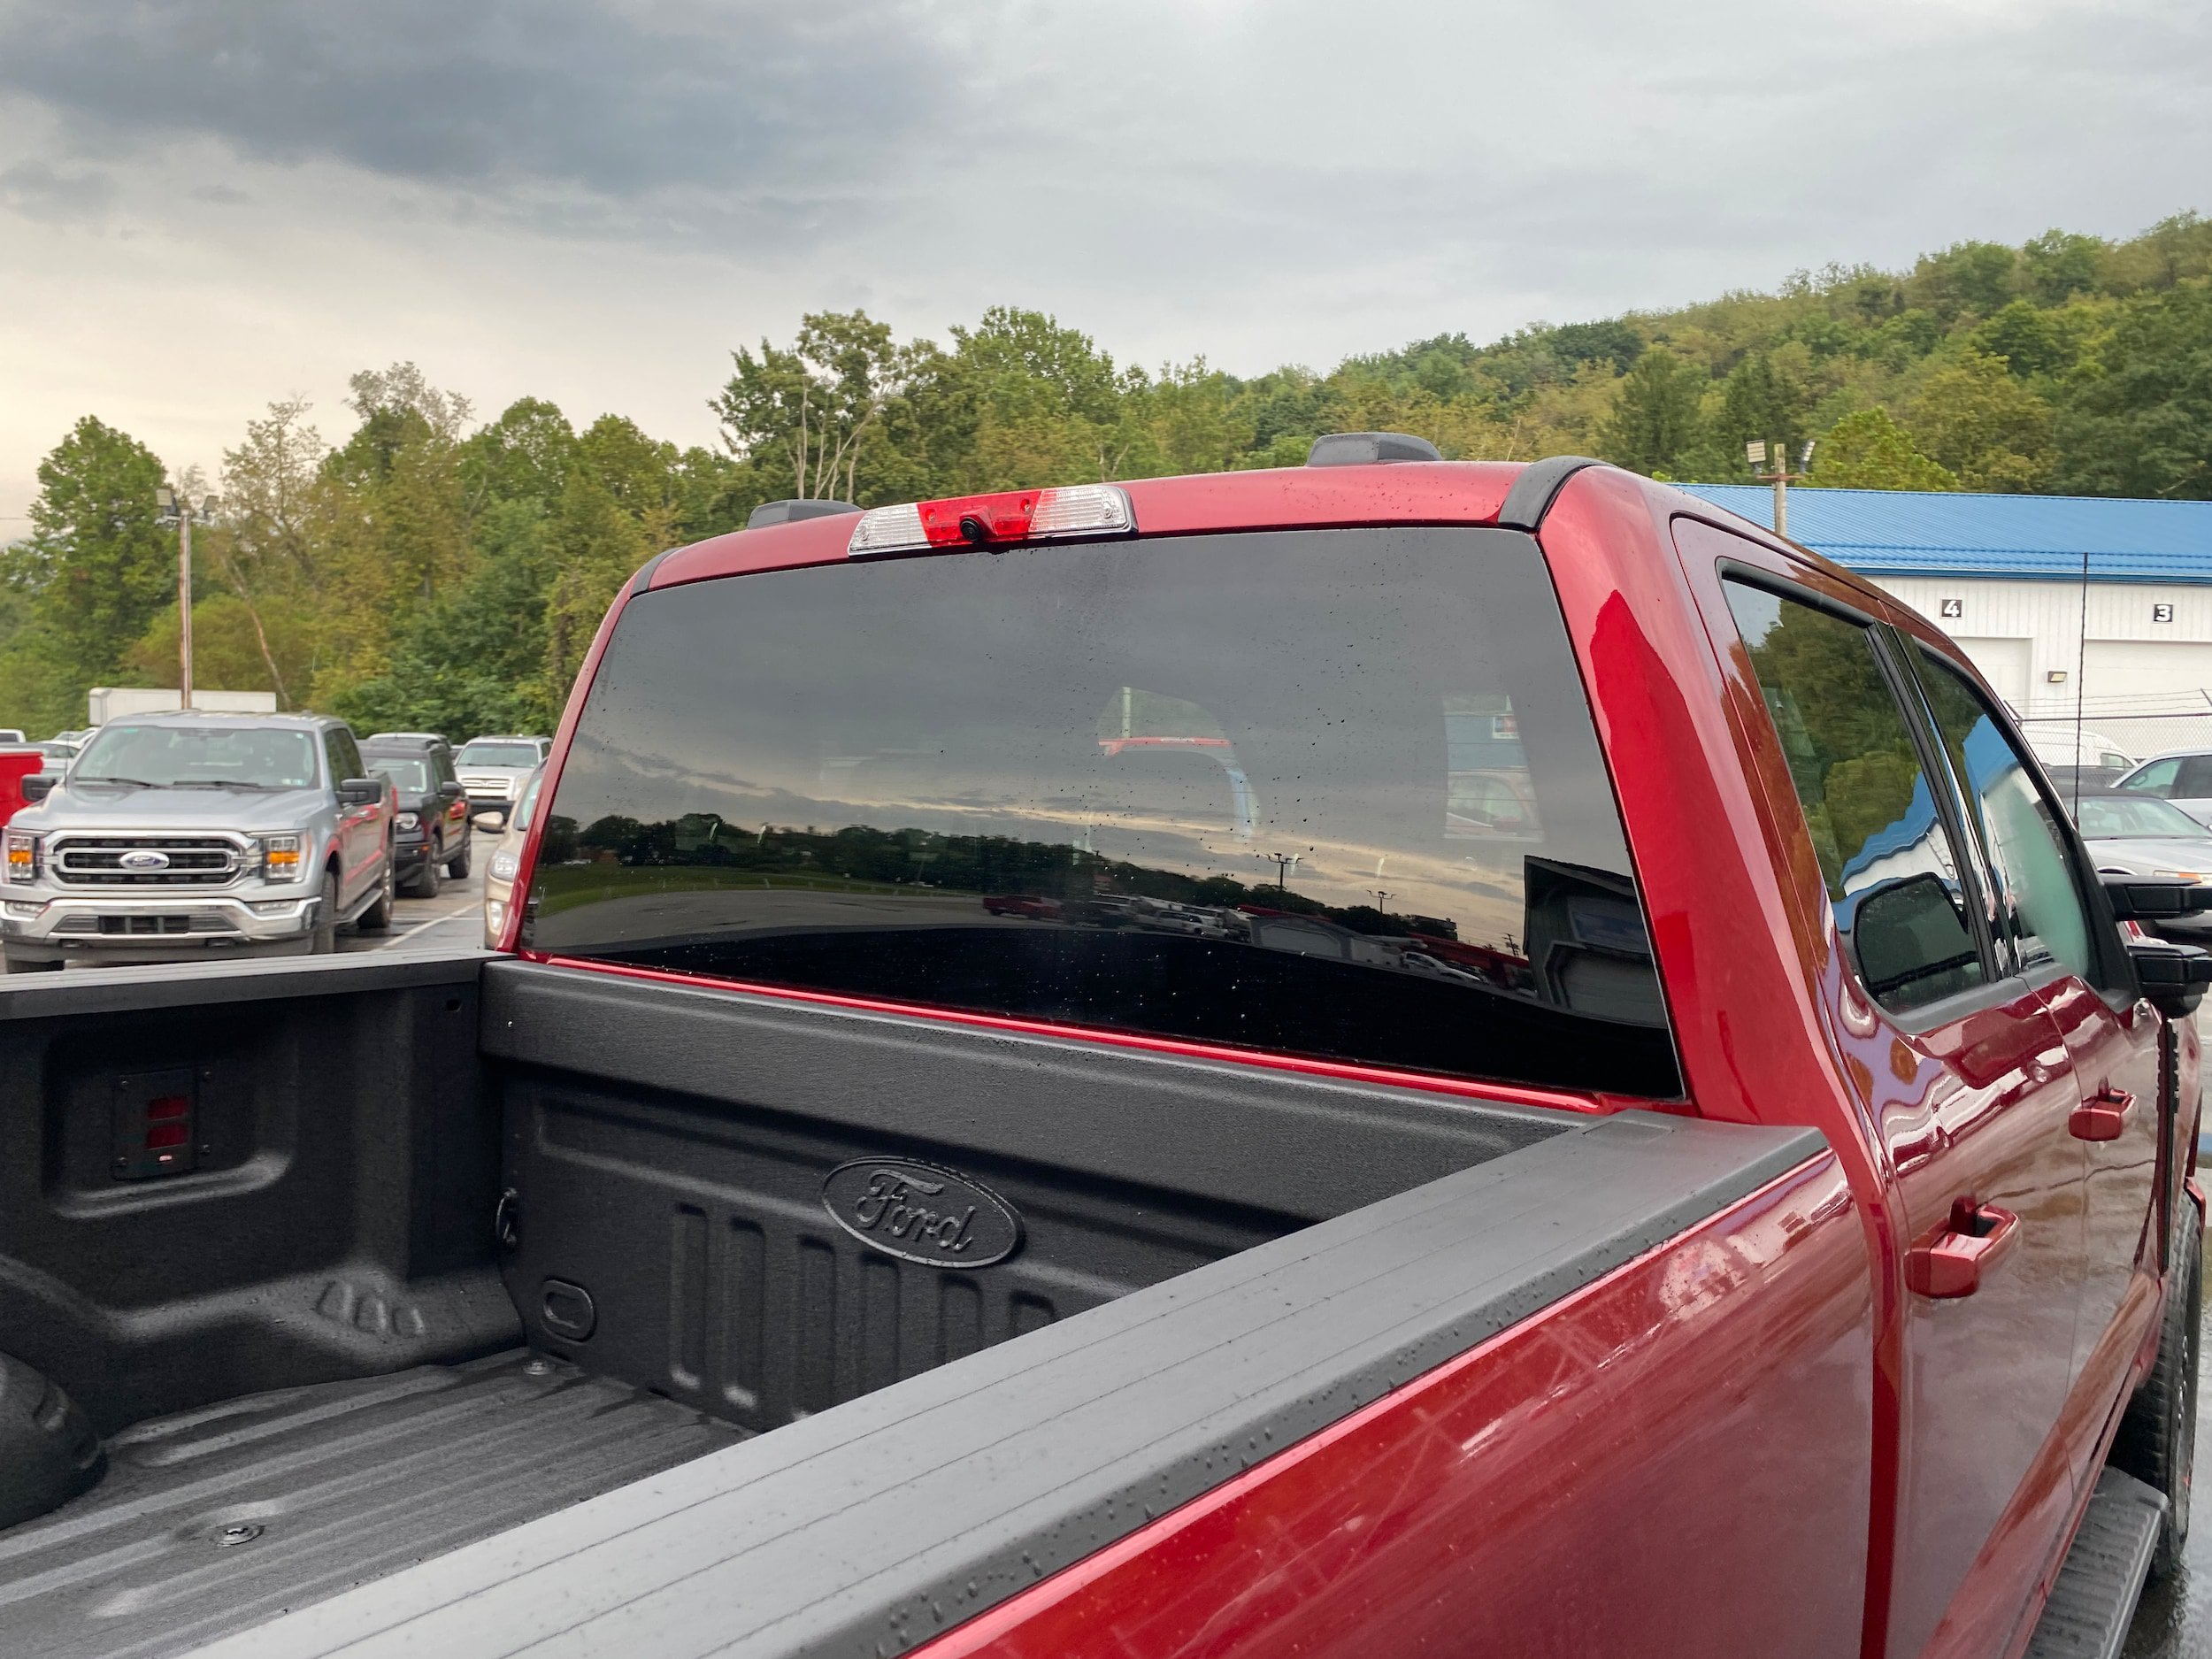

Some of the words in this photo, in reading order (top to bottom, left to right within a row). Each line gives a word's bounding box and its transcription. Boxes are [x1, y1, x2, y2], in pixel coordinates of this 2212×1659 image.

[1944, 600, 1960, 618] 4
[2155, 604, 2170, 622] 3
[856, 1168, 976, 1251] Ford
